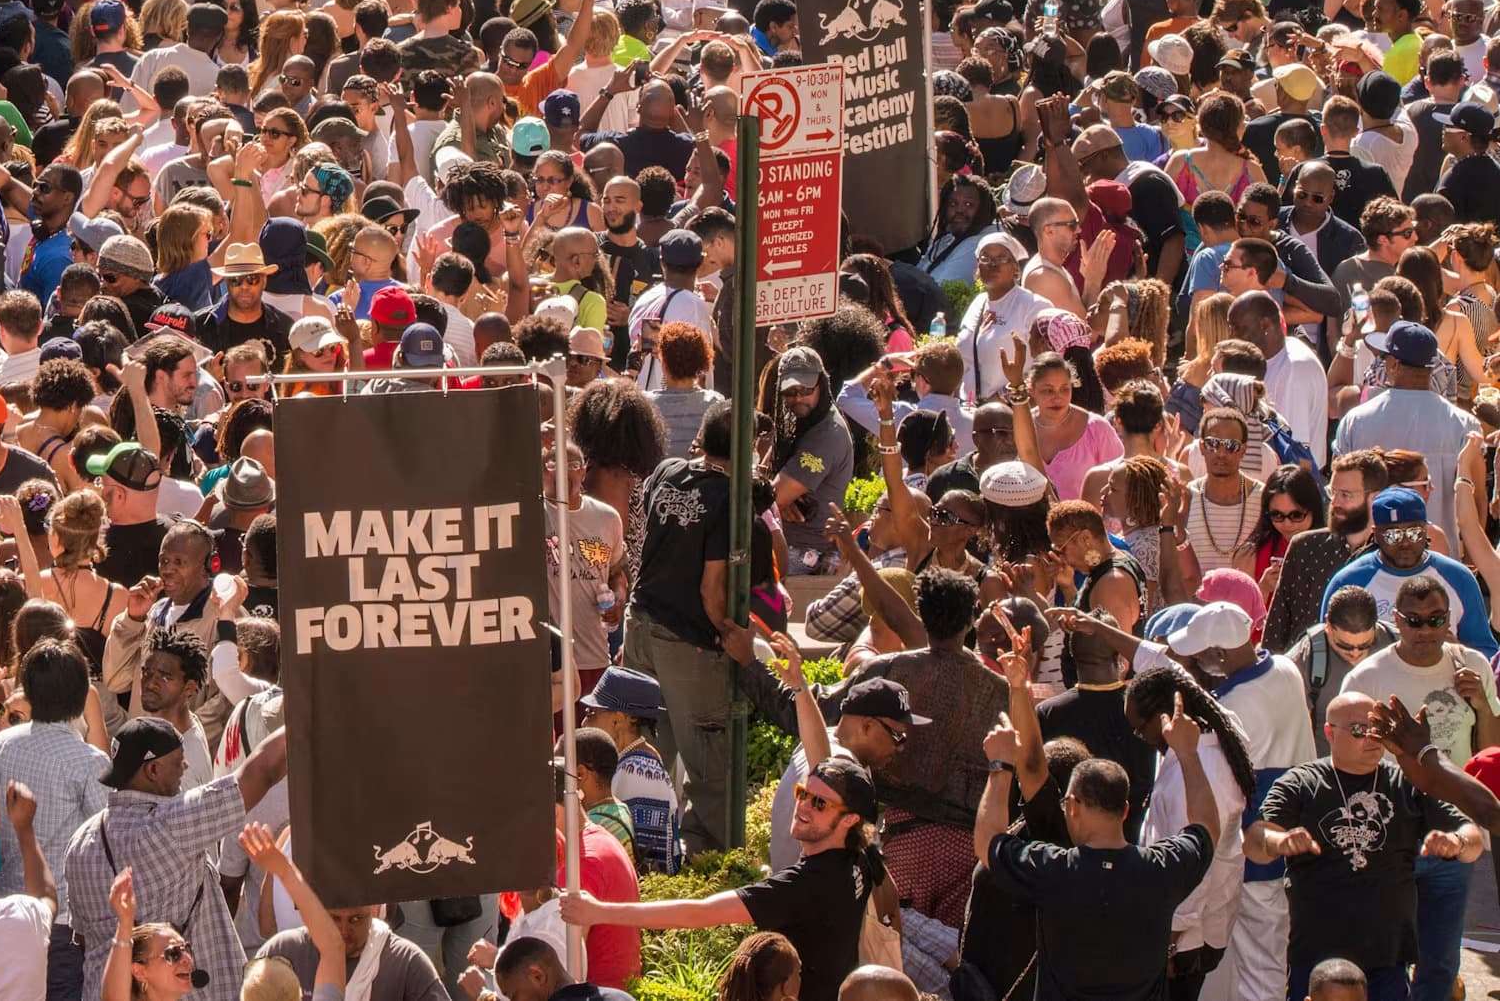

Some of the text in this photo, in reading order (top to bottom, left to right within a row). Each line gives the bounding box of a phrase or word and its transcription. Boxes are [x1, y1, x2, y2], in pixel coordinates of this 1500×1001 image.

[873, 36, 908, 69] Bull
[845, 66, 900, 101] Music
[810, 89, 828, 99] MON
[844, 90, 915, 127] cademy
[806, 115, 832, 127] THURS
[769, 159, 833, 183] STANDING
[796, 185, 821, 202] 6PM
[763, 205, 814, 219] MON THRU FRI
[772, 220, 804, 232] EXCEPT
[762, 231, 814, 245] AUTHORIZED
[767, 244, 808, 257] VEHICLES
[774, 285, 804, 301] DEPT
[809, 283, 825, 296] OF
[756, 295, 827, 317] GRICULTURE
[304, 502, 520, 558] MAKE IT
[348, 553, 481, 602] LAST
[295, 595, 537, 654] FOREVER
